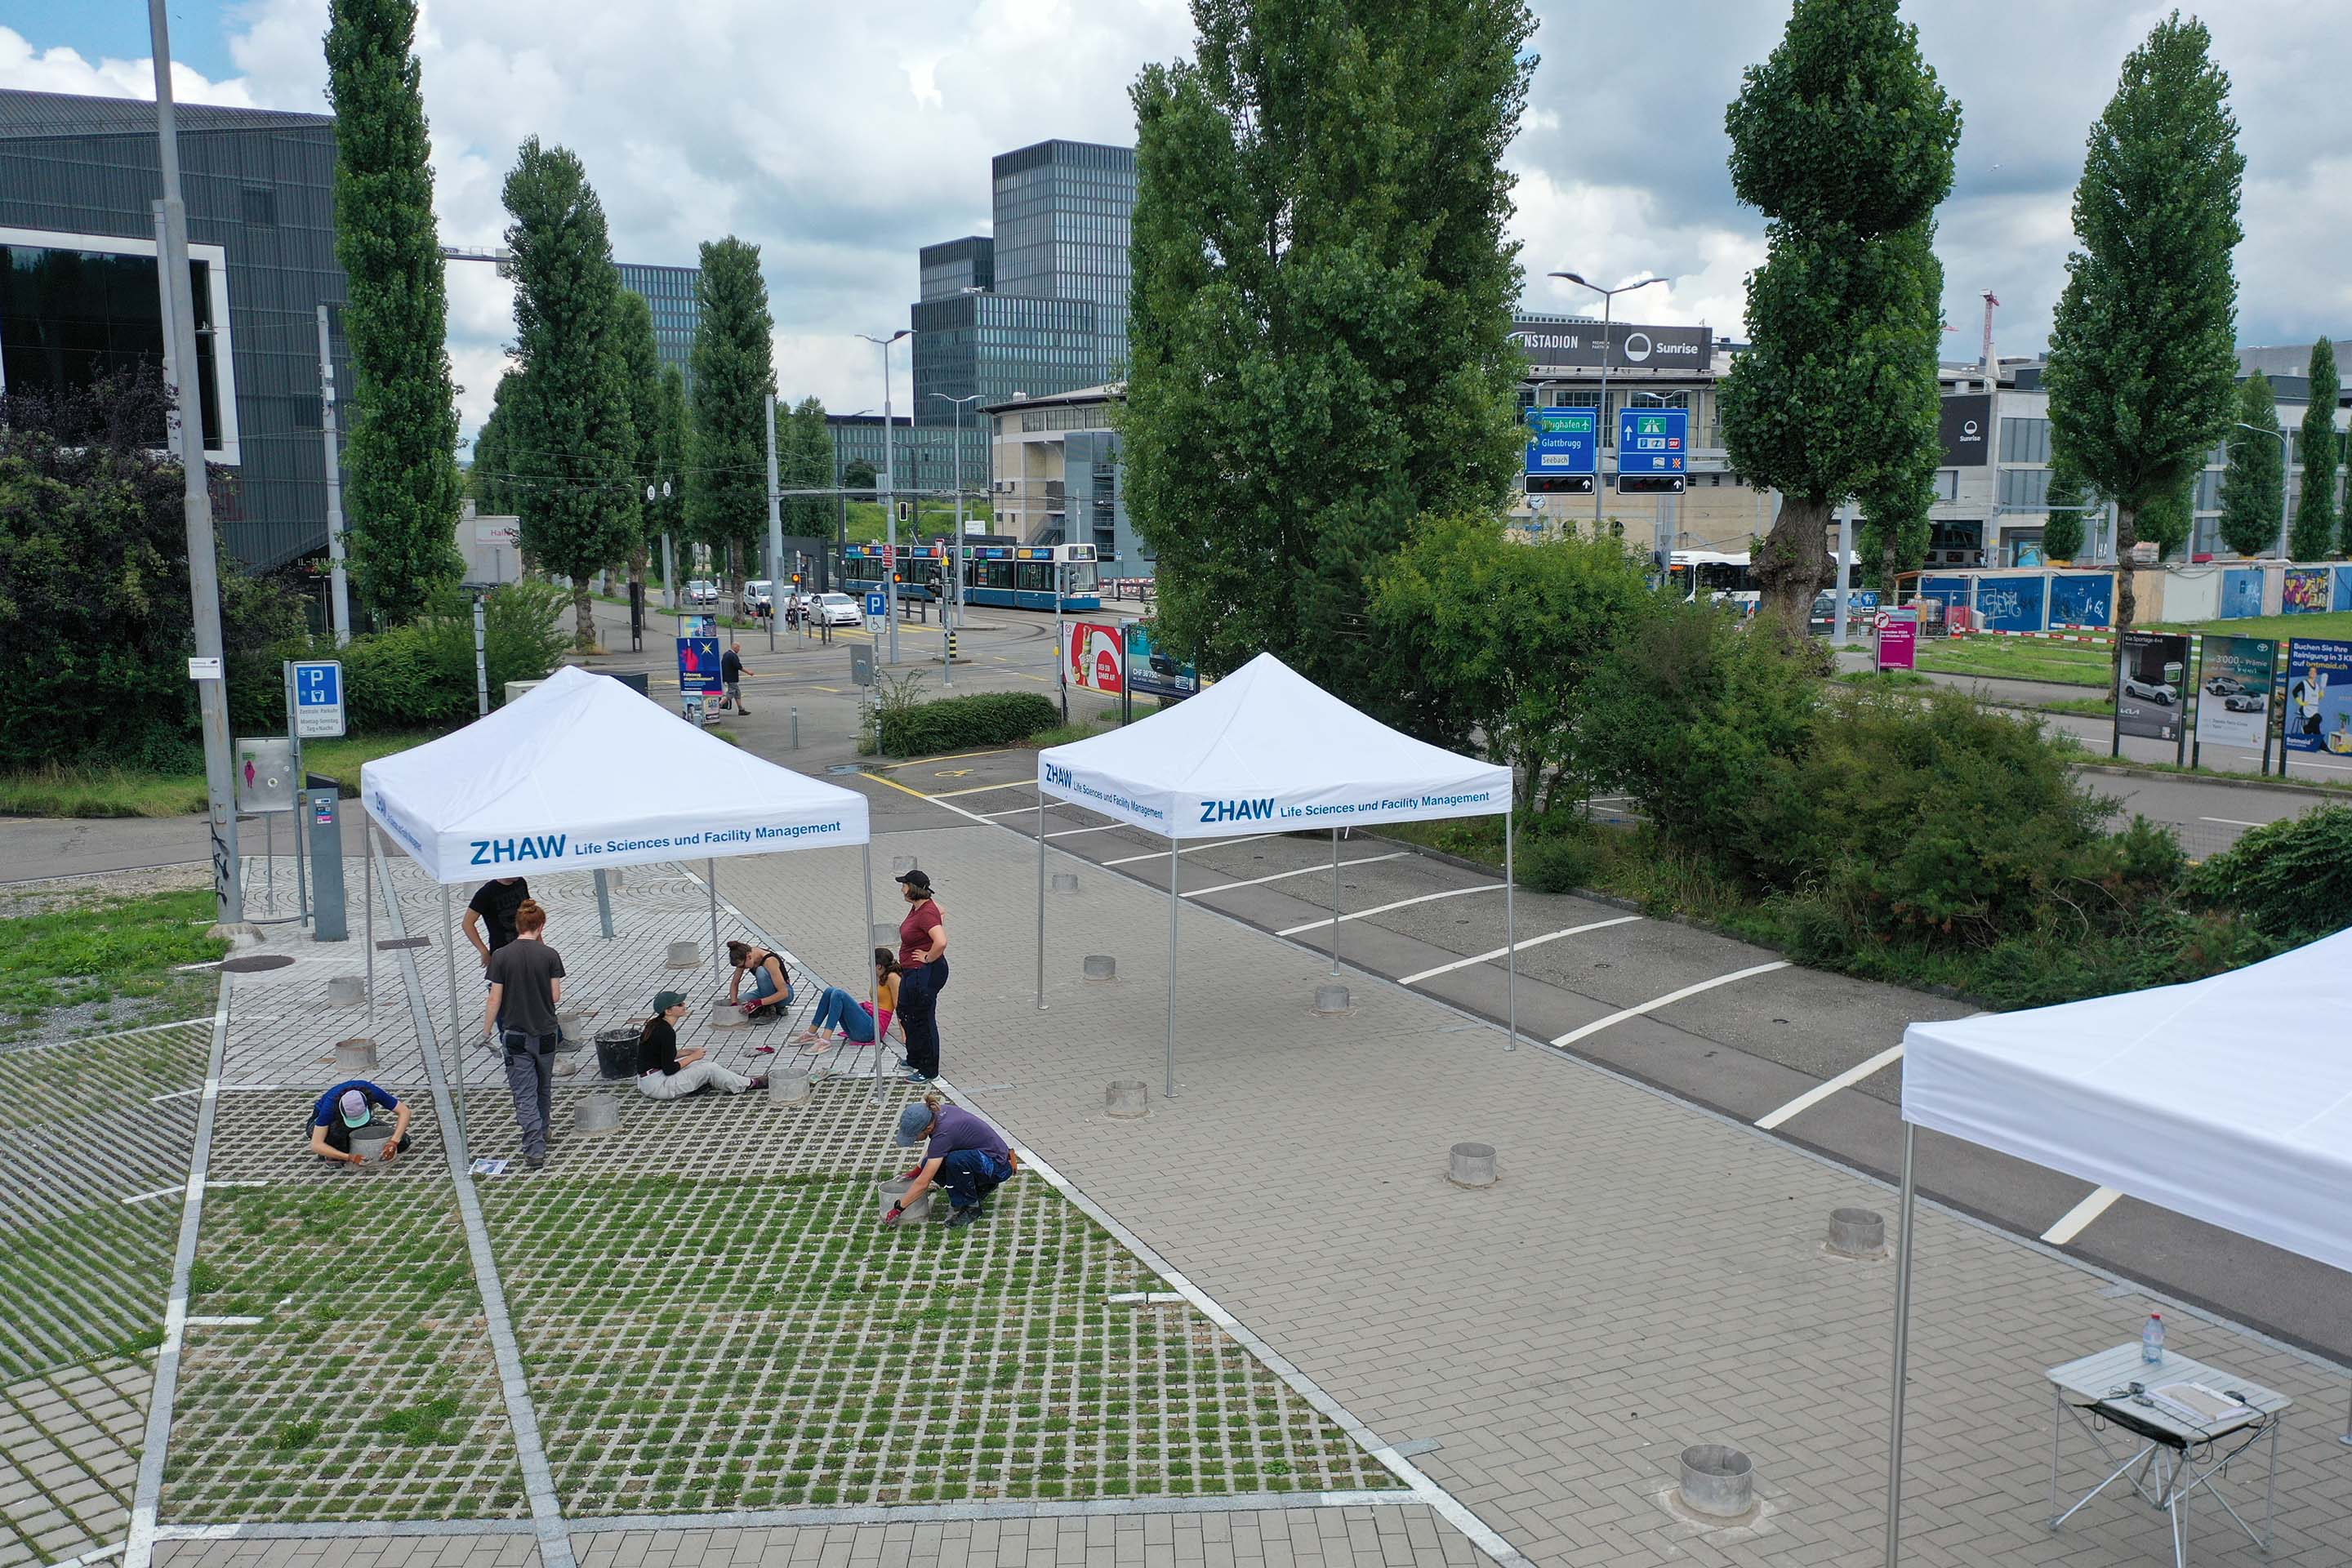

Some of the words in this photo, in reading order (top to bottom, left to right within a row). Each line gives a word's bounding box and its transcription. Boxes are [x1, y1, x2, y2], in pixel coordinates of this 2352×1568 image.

[1656, 342, 1698, 354] Sunrise
[1542, 439, 1581, 449] Glattbrugg
[871, 597, 880, 612] P
[2293, 643, 2319, 651] Buchen
[2293, 651, 2328, 662] Reinigung
[2246, 659, 2268, 667] Prämie
[2305, 661, 2348, 670] batmaid.ch
[311, 670, 323, 687] P
[1045, 763, 1072, 789] ZHAW
[1073, 781, 1082, 792] Life
[1083, 784, 1103, 800] Sciences
[1103, 792, 1113, 803] und
[1113, 795, 1130, 811] Facility
[1131, 800, 1163, 820] Management
[1200, 798, 1275, 823] ZHAW
[1280, 807, 1302, 817] Life
[1306, 804, 1355, 816] Sciences
[1358, 800, 1379, 812] und
[1381, 797, 1419, 810] Facility
[1421, 791, 1490, 807] Management
[470, 834, 567, 866] ZHAW
[575, 842, 602, 855] Life
[607, 837, 670, 853] Sciences
[675, 833, 700, 846] und
[704, 828, 751, 844] Facility
[755, 821, 841, 840] Management
